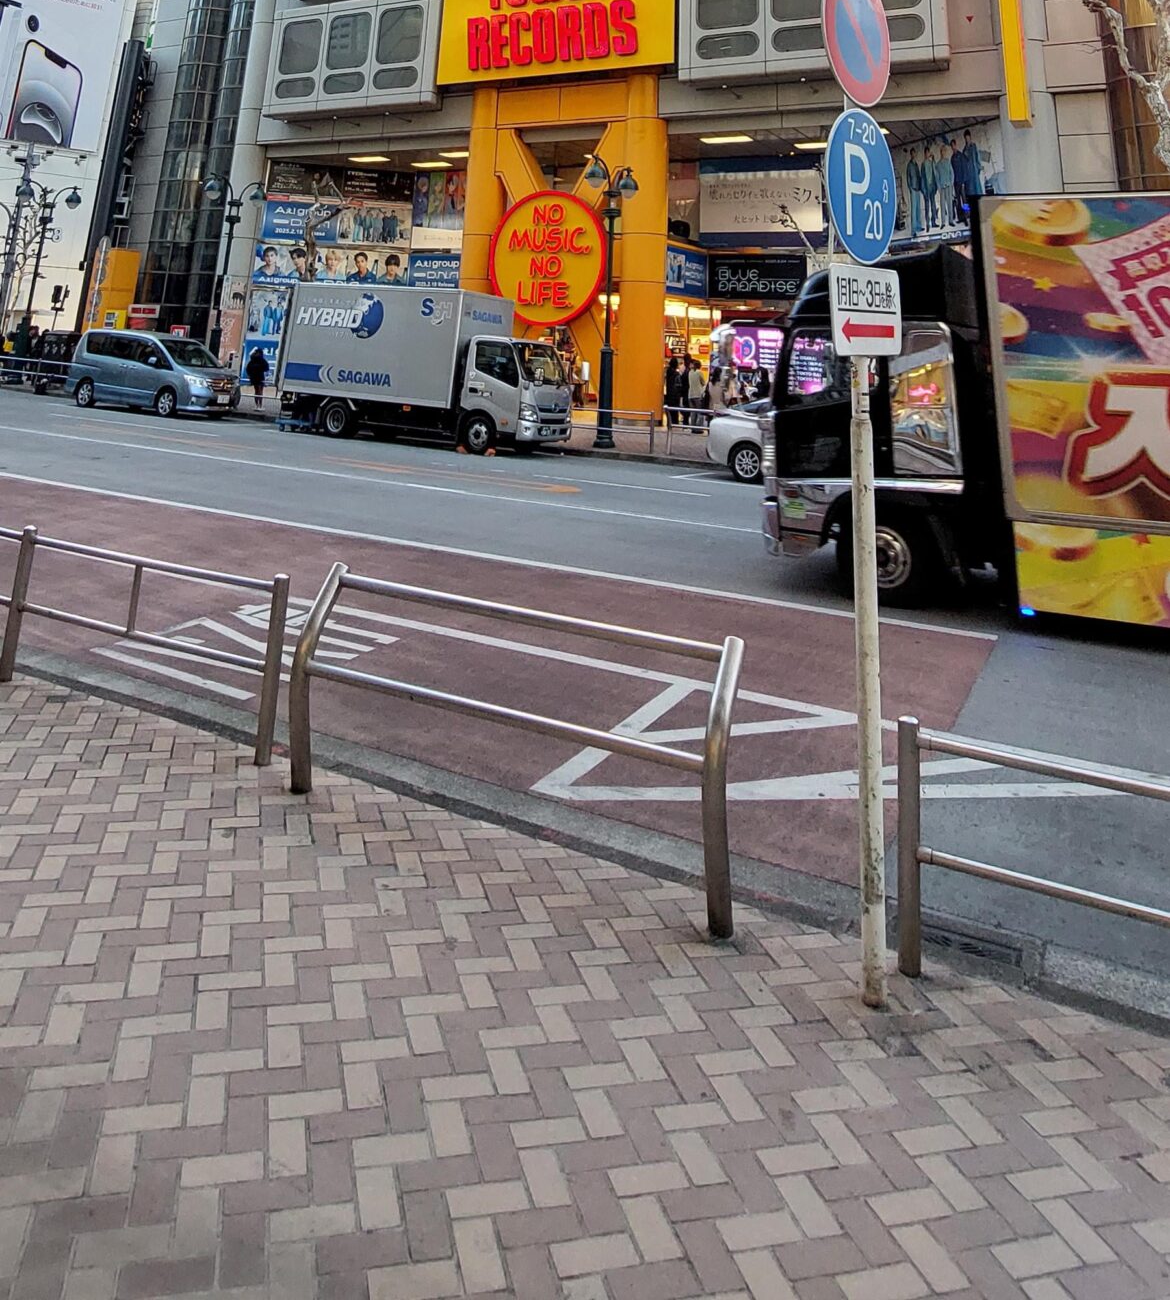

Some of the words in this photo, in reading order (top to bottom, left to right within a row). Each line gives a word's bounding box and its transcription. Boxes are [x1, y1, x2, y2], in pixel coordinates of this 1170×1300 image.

[848, 118, 876, 146] 7-20
[844, 142, 871, 235] P
[533, 204, 564, 225] NO
[864, 199, 883, 241] 20
[432, 260, 460, 269] group
[529, 255, 562, 277] NO
[718, 268, 760, 281] BLUE
[516, 280, 572, 308] LIFE.
[296, 306, 364, 329] HYBRID
[473, 309, 503, 325] SAGAWA
[337, 369, 391, 387] SAGAWA
